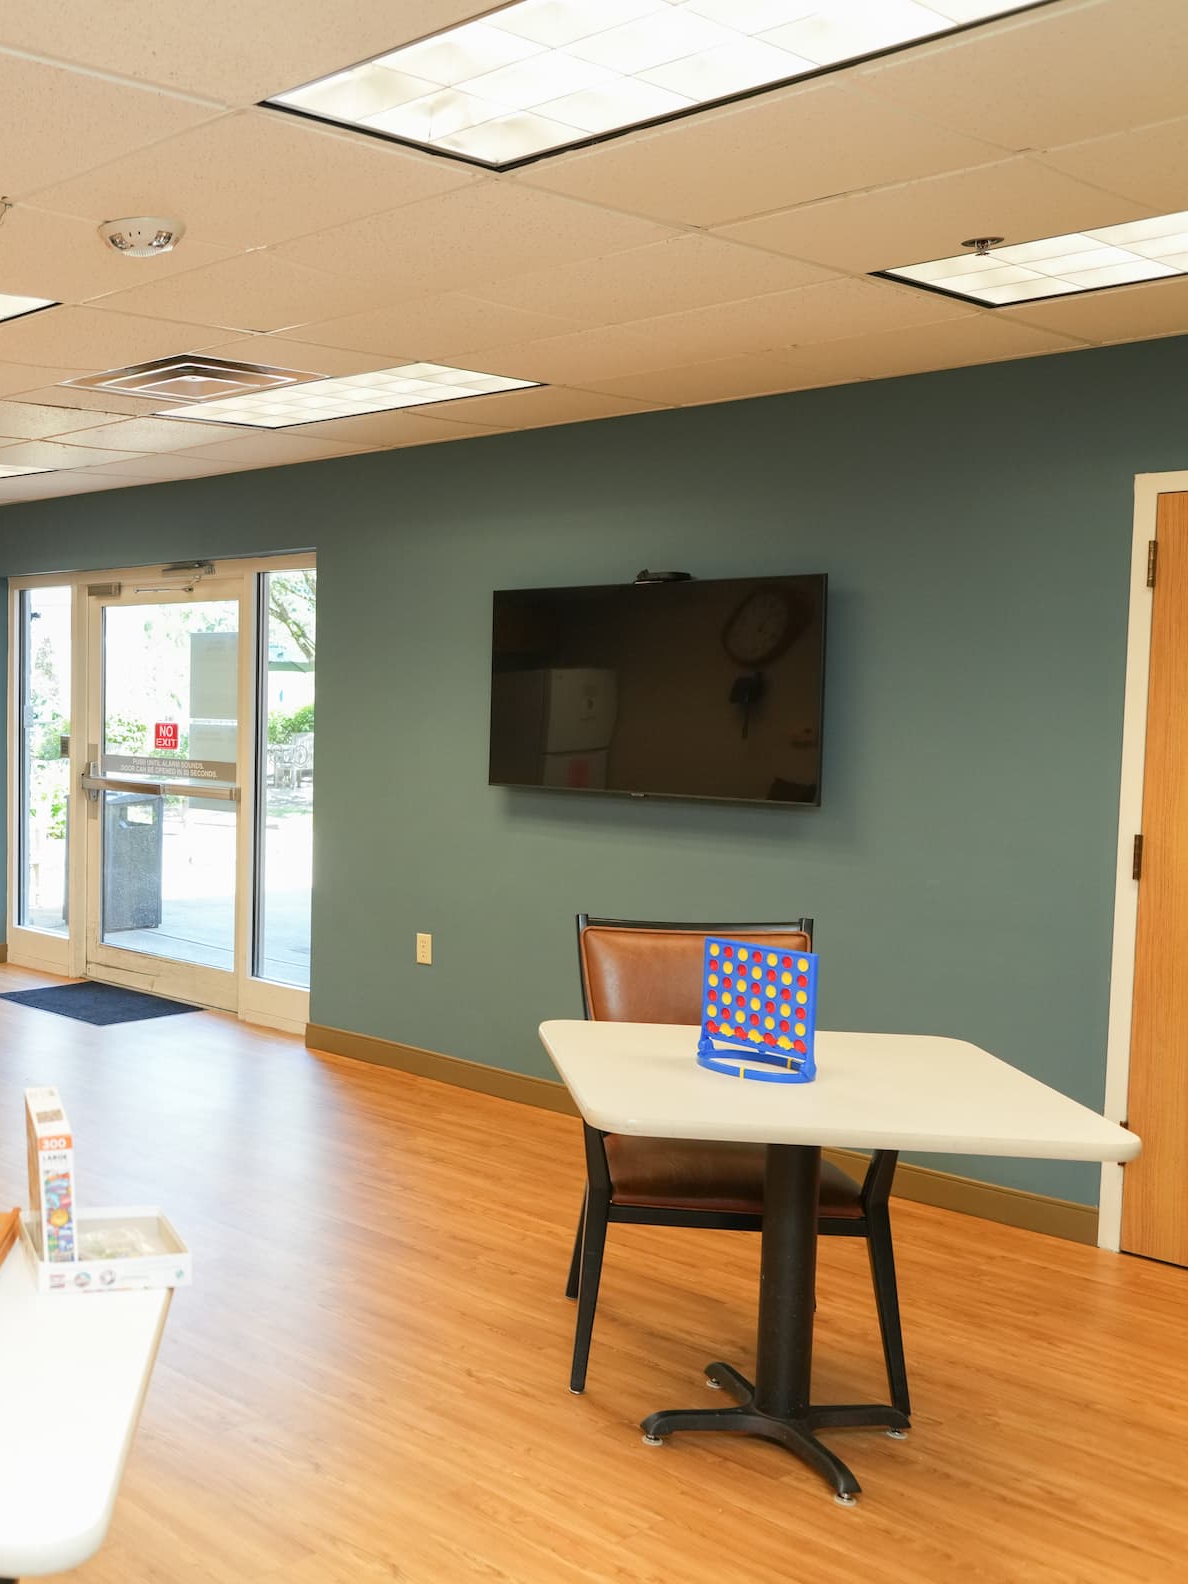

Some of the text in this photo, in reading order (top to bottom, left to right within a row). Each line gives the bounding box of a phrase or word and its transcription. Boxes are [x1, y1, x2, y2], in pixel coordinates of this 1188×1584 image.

[159, 725, 173, 737] NO
[156, 738, 176, 747] EXIT
[132, 758, 146, 766] PUSH
[147, 759, 161, 767] UNTIL
[162, 760, 180, 768] ALARM
[121, 764, 135, 772] DOOR
[155, 767, 177, 775] OPENED
[43, 1138, 66, 1149] 300
